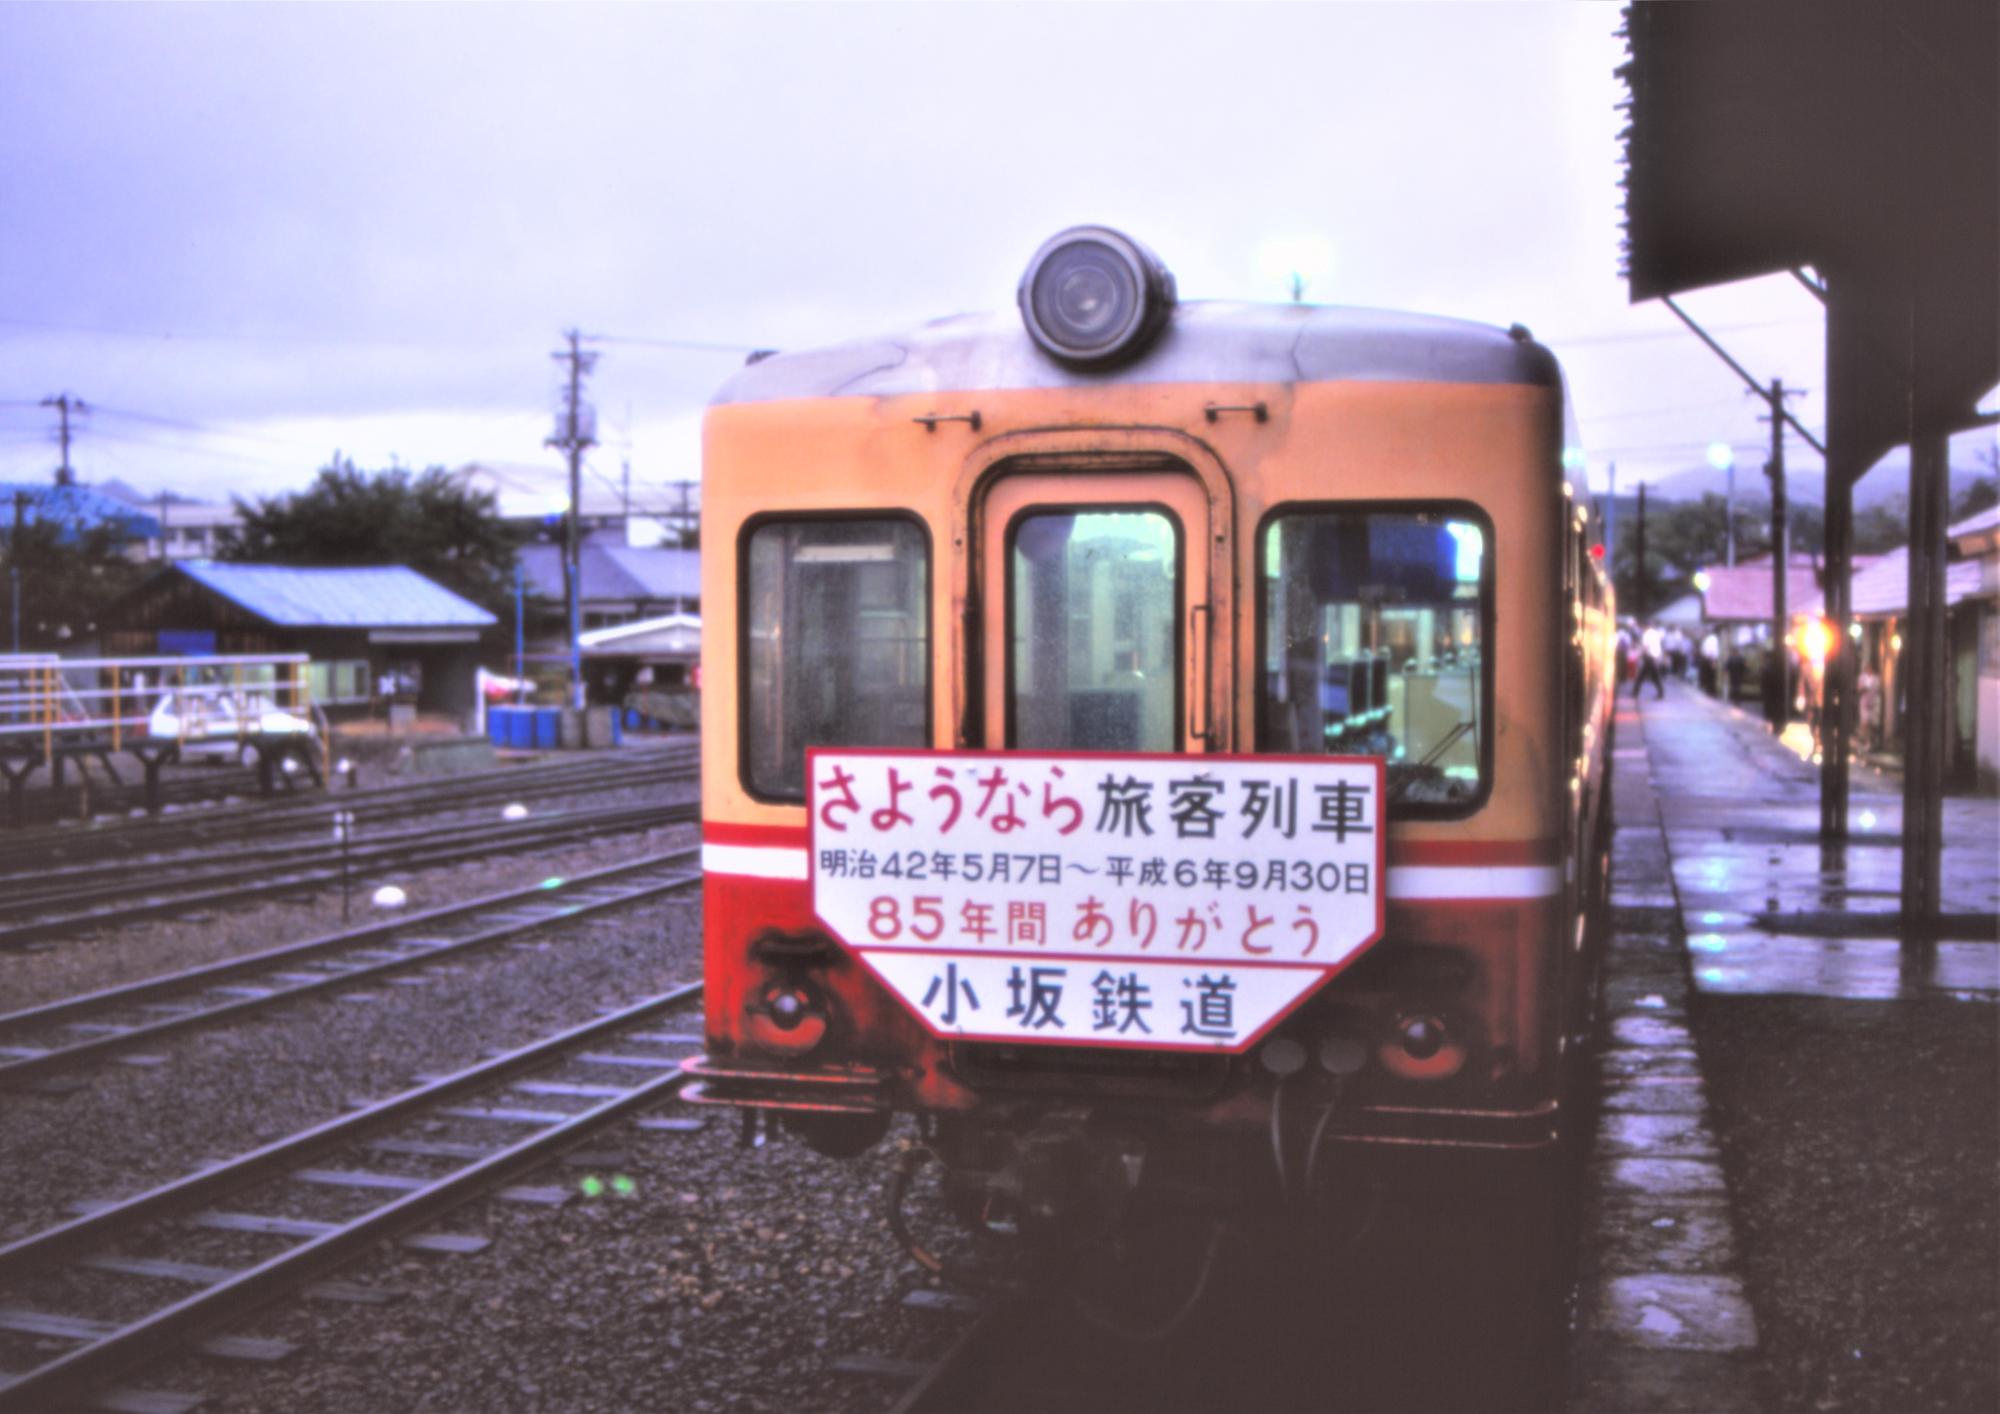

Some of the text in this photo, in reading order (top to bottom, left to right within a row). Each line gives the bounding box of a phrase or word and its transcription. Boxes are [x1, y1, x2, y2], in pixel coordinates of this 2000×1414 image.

[818, 764, 1374, 843] さようなら旅客列車
[921, 962, 1239, 1039] 小坂鉄道
